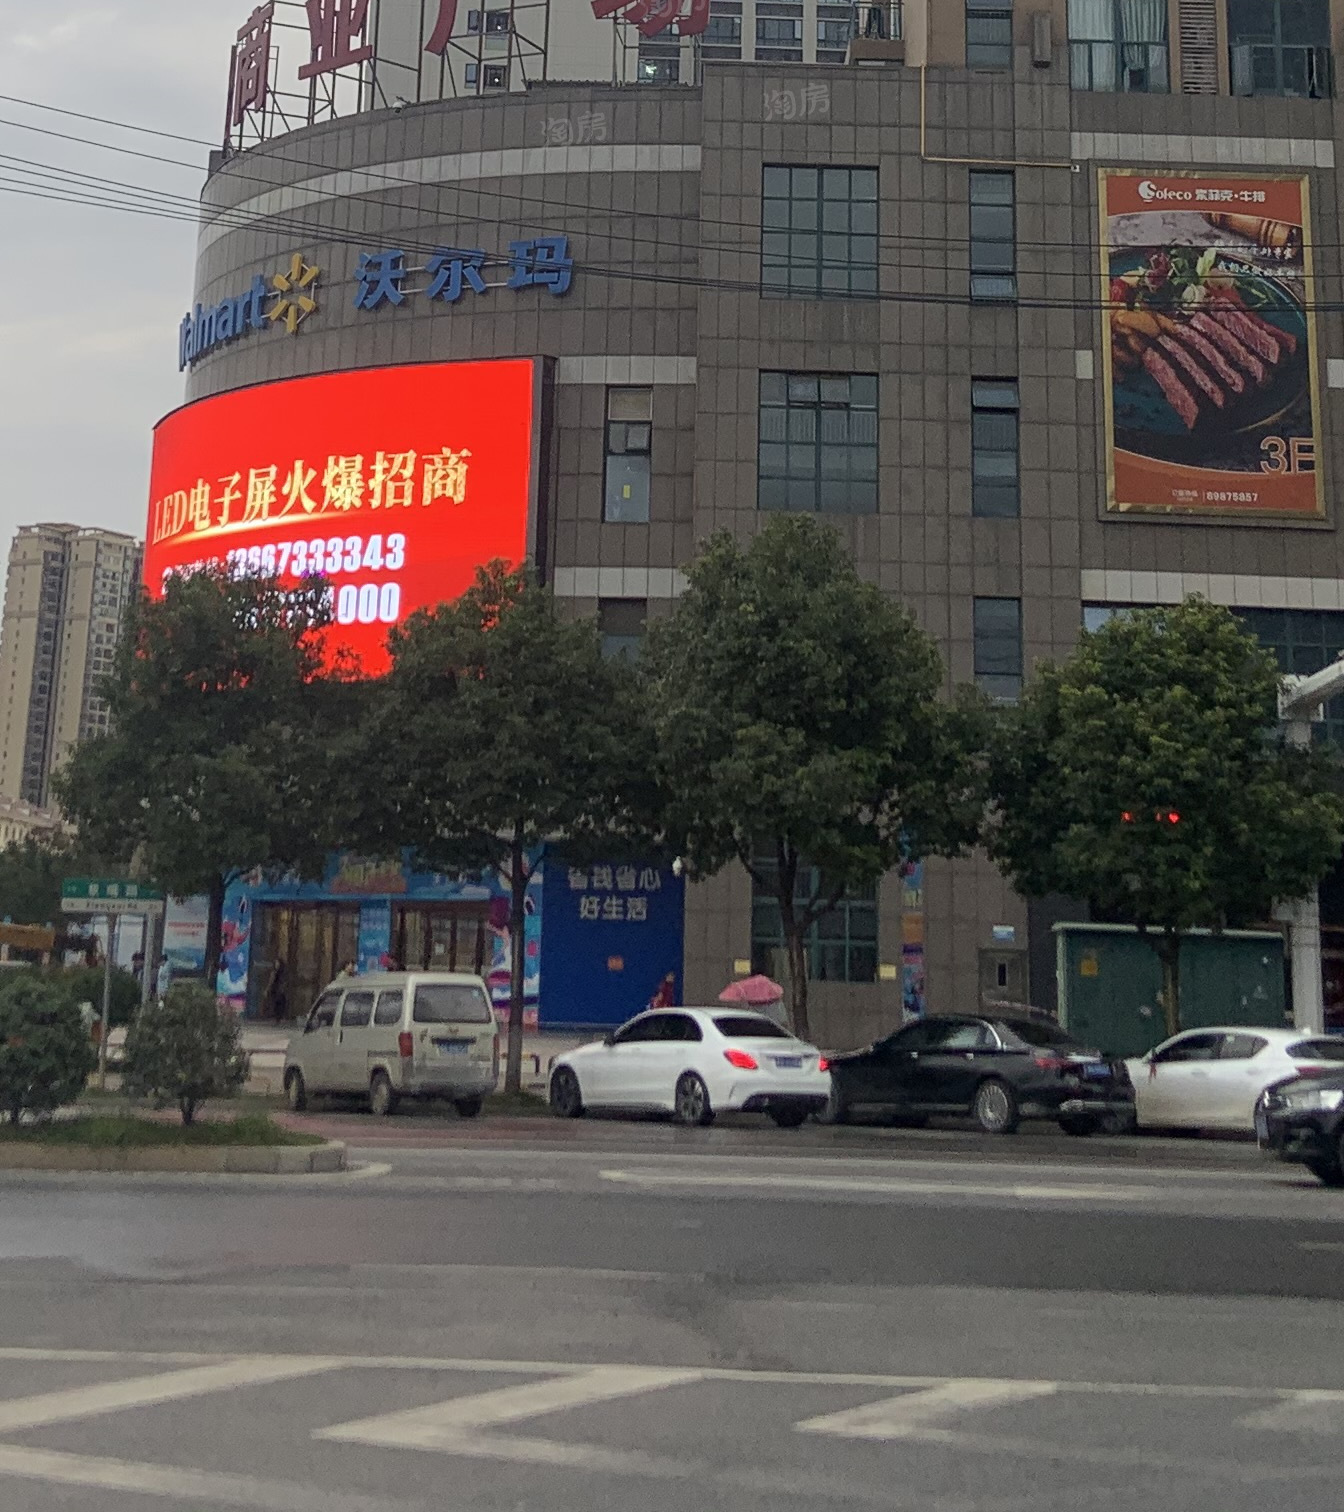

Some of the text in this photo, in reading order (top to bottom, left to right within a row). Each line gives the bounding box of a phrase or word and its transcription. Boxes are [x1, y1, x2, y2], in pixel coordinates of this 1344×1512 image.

[354, 235, 574, 310] 沃尔玛
[151, 446, 473, 546] LED电子屏火爆招商
[578, 894, 648, 921] 好生活
